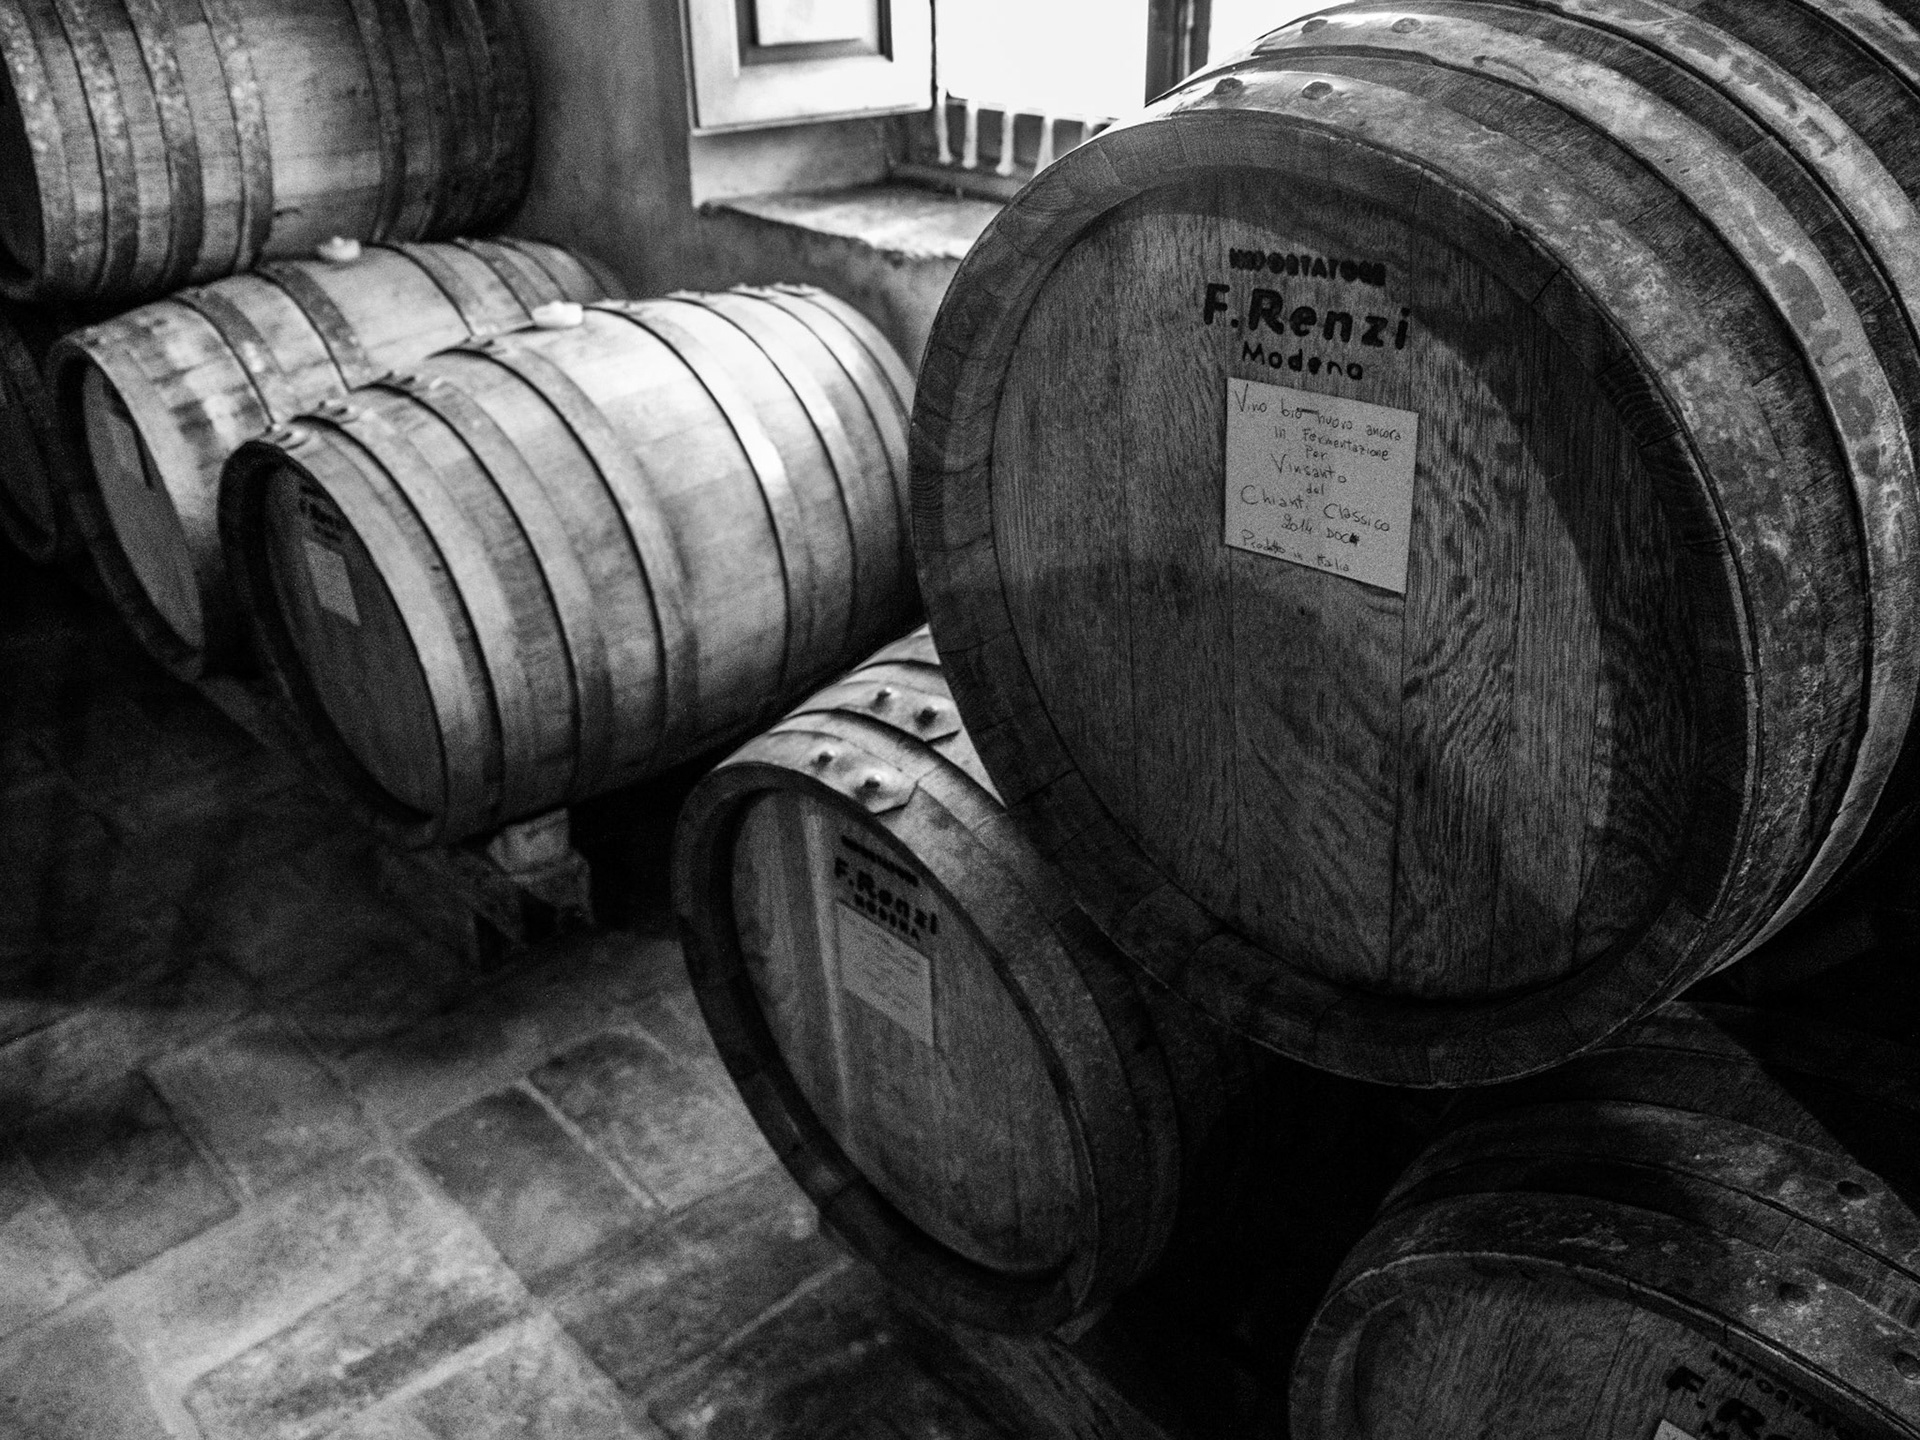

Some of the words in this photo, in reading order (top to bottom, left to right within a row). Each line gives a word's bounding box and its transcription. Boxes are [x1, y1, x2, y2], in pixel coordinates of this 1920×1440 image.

[1241, 340, 1364, 381] Modena
[1233, 382, 1268, 413] Vino
[1366, 424, 1402, 442] ancora
[1271, 453, 1348, 484] Vinsanto
[1323, 502, 1391, 532] Classico
